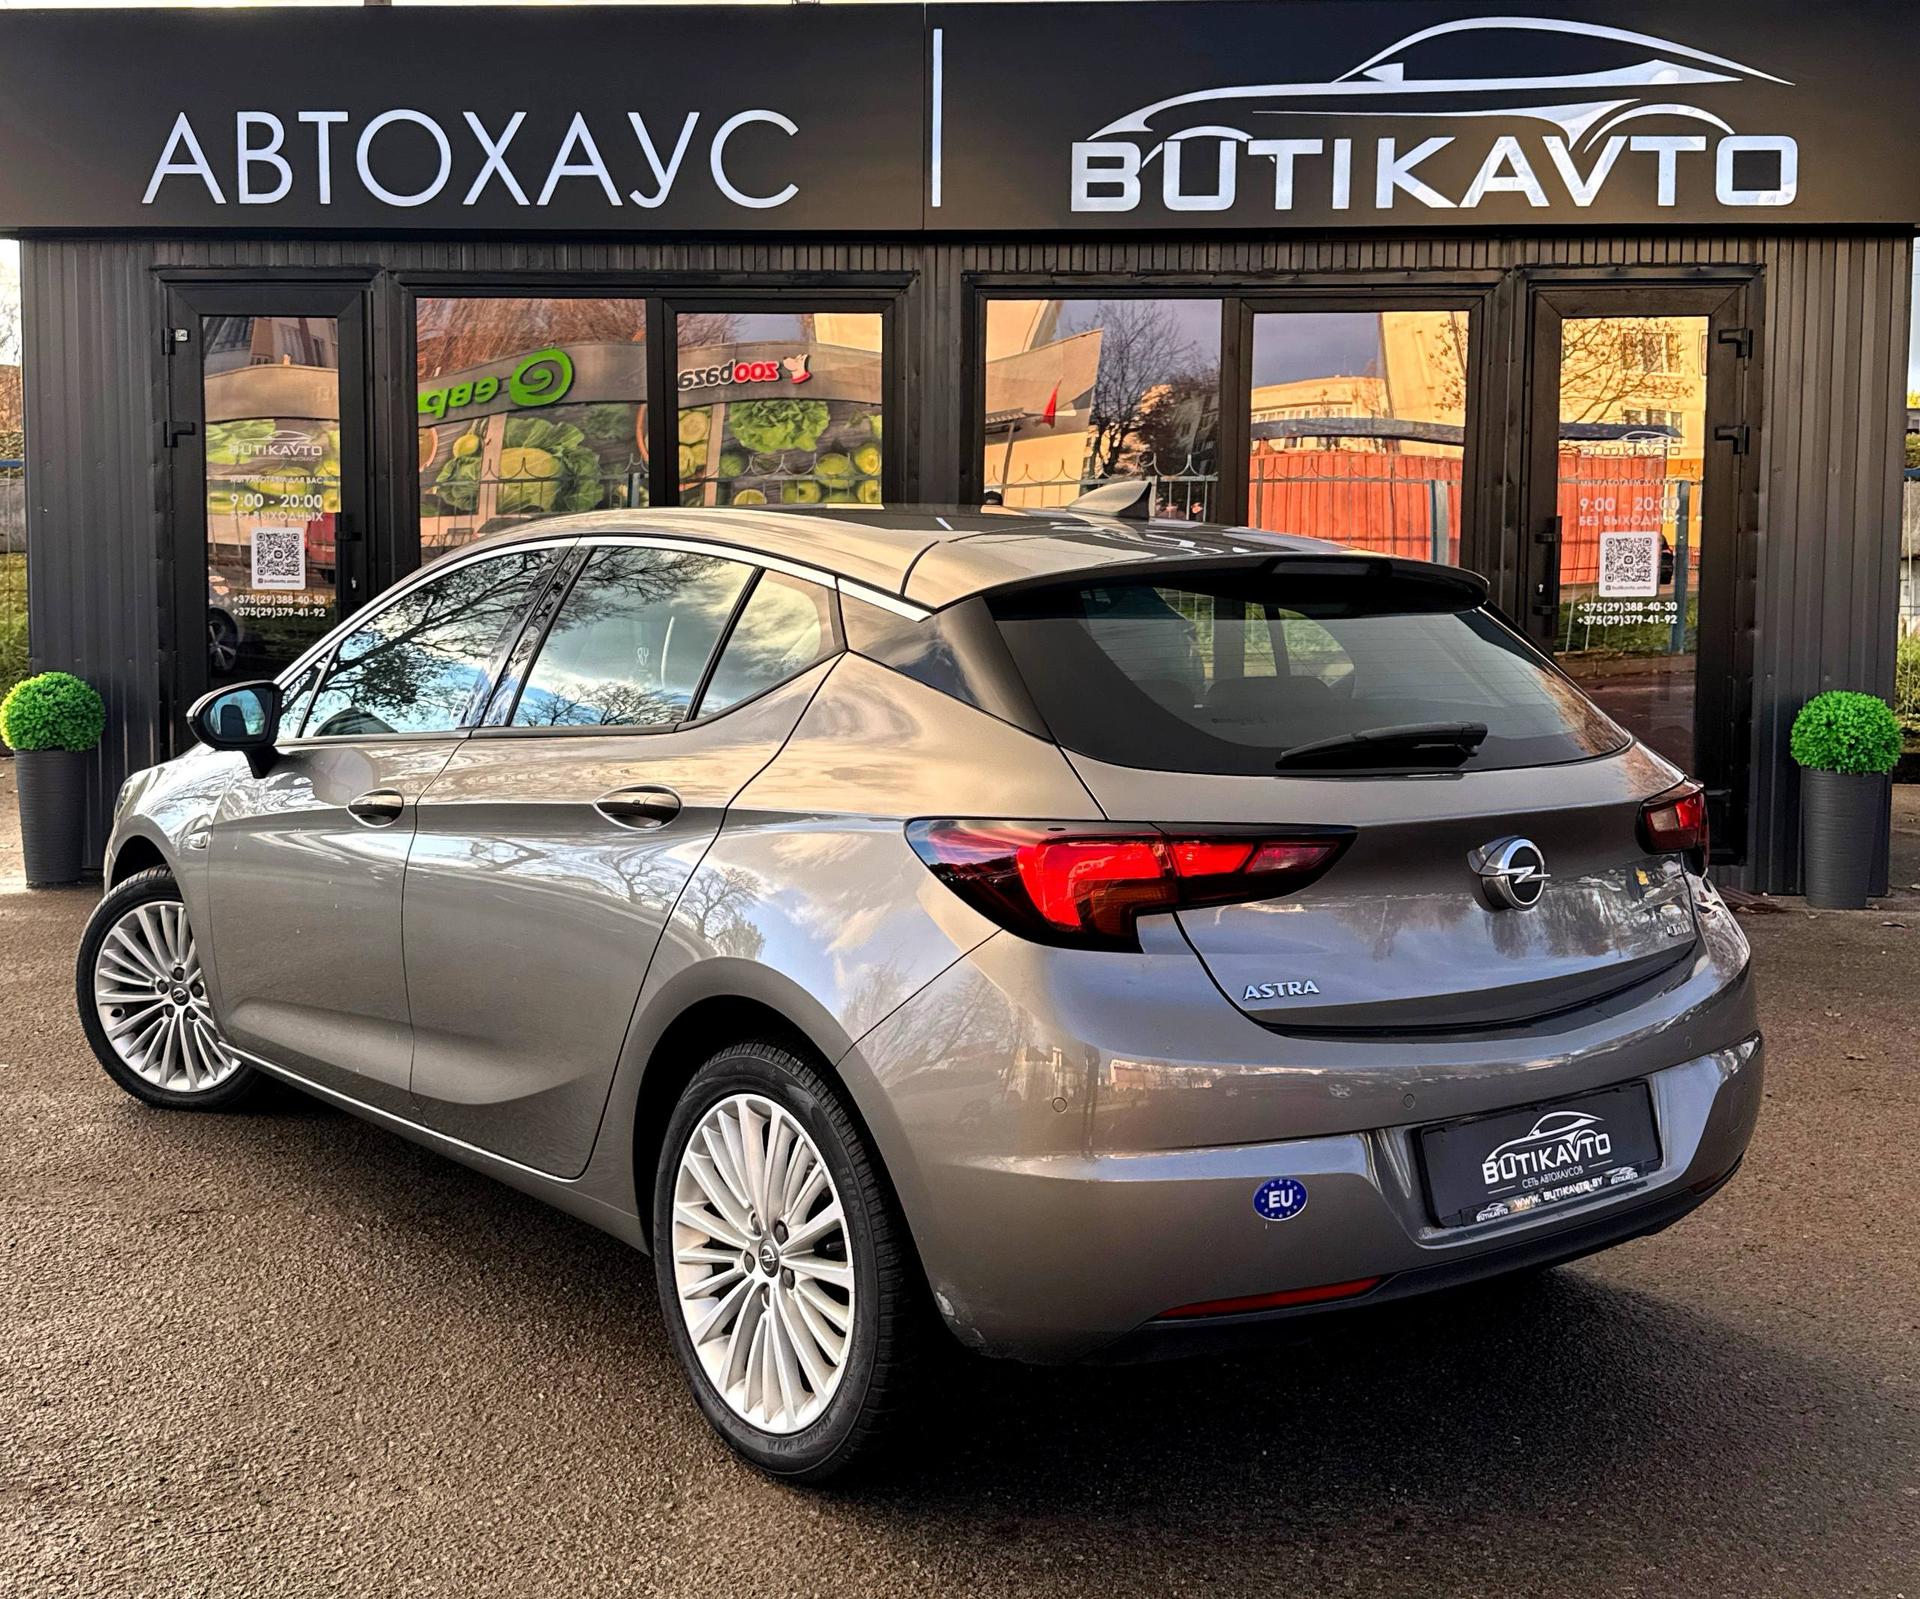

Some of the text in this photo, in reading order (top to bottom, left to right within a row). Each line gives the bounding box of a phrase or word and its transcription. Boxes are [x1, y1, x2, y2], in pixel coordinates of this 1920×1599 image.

[142, 109, 800, 208] АВТОХАУС
[1071, 134, 1798, 213] BUTIKAVTO
[229, 445, 323, 456] BUTIKAVTO
[307, 476, 323, 484] ВАС
[230, 493, 264, 508] 9:00
[281, 494, 325, 509] 20:00
[1579, 497, 1616, 512] 9:00
[1633, 496, 1682, 512] 20:00
[1579, 516, 1599, 527] БЕЗ
[232, 595, 326, 606] +375(29)388-40-30
[1577, 602, 1678, 613] +375(29)388-40-30
[232, 607, 326, 618] +375(29)379-41-92
[1577, 614, 1678, 626] +375(29)379-41-92
[1243, 979, 1320, 1001] ASTRA
[1482, 1132, 1612, 1185] BUTIKAVTO
[1521, 1165, 1584, 1189] СЕТЬ АВТОХАУСОВ
[1268, 1189, 1294, 1208] EU
